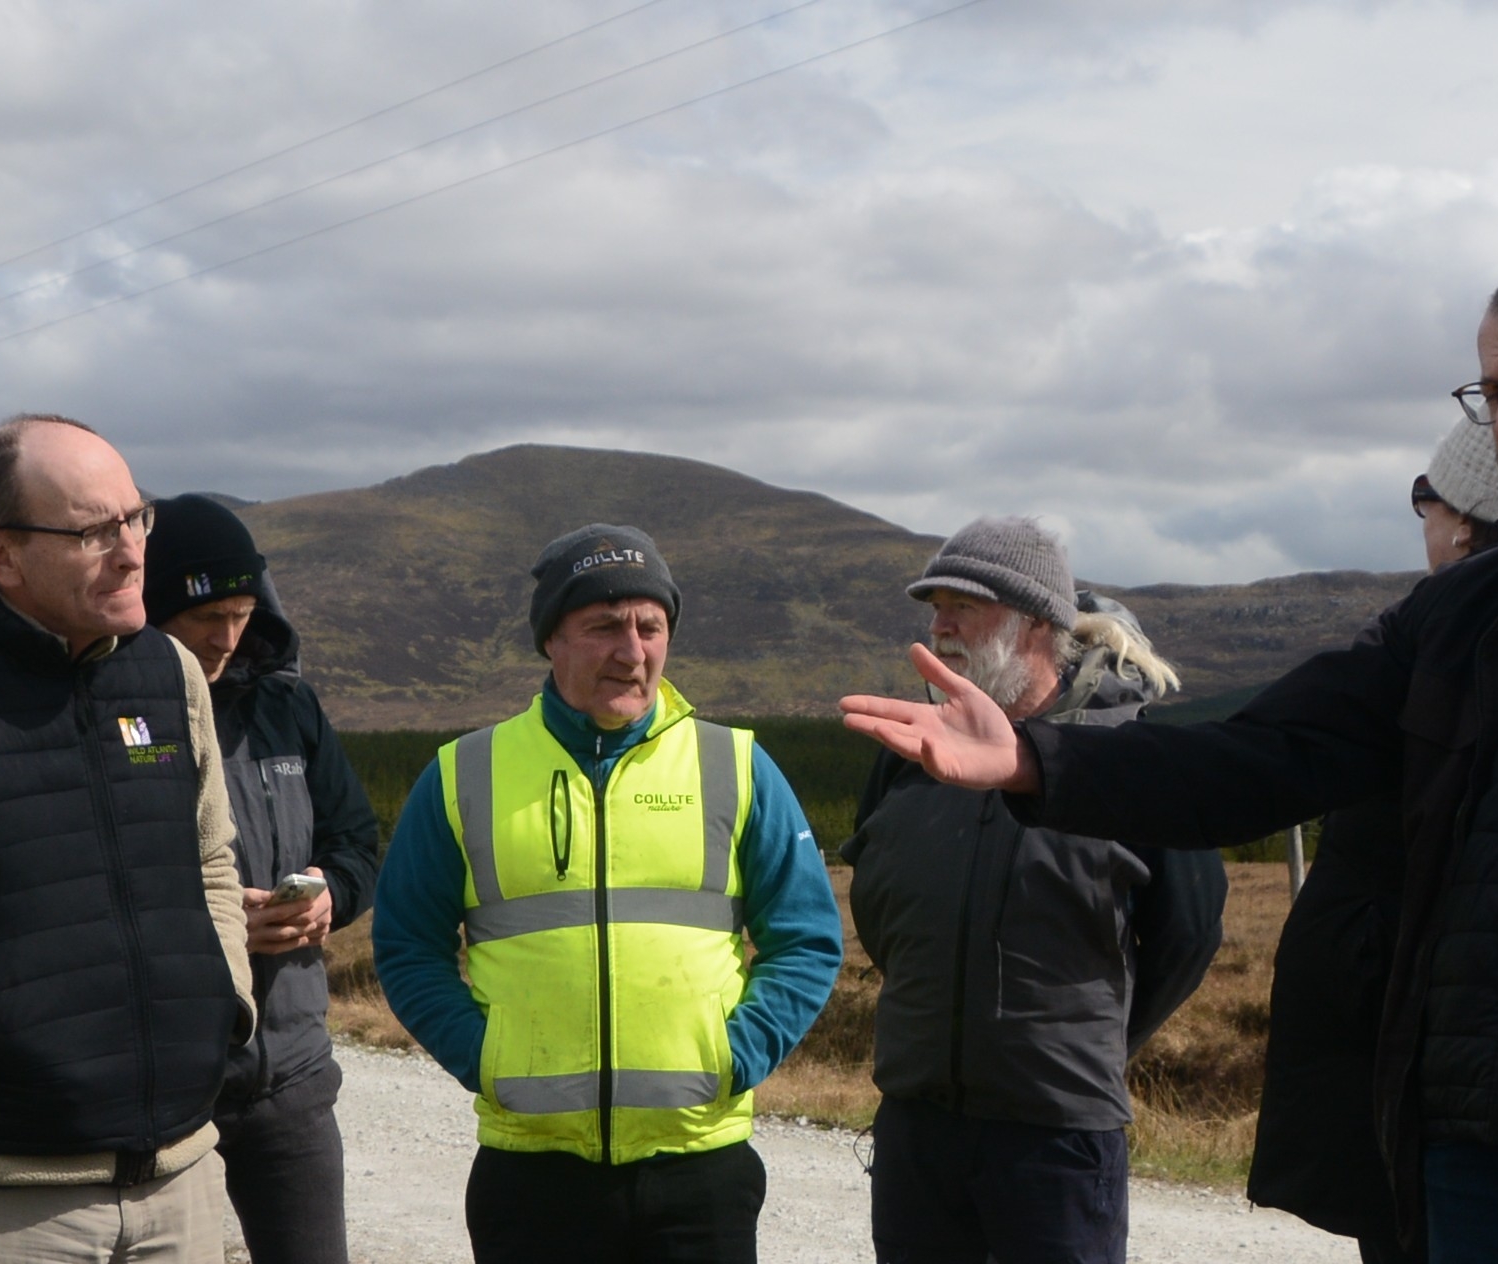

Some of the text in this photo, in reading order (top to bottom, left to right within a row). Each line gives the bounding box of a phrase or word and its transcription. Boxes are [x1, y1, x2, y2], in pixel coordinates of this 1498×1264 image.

[573, 549, 645, 573] COILLTE
[127, 744, 177, 755] WILD ATLANTIC
[129, 753, 173, 764] NATURE LIFE
[634, 793, 695, 805] COILLTE
